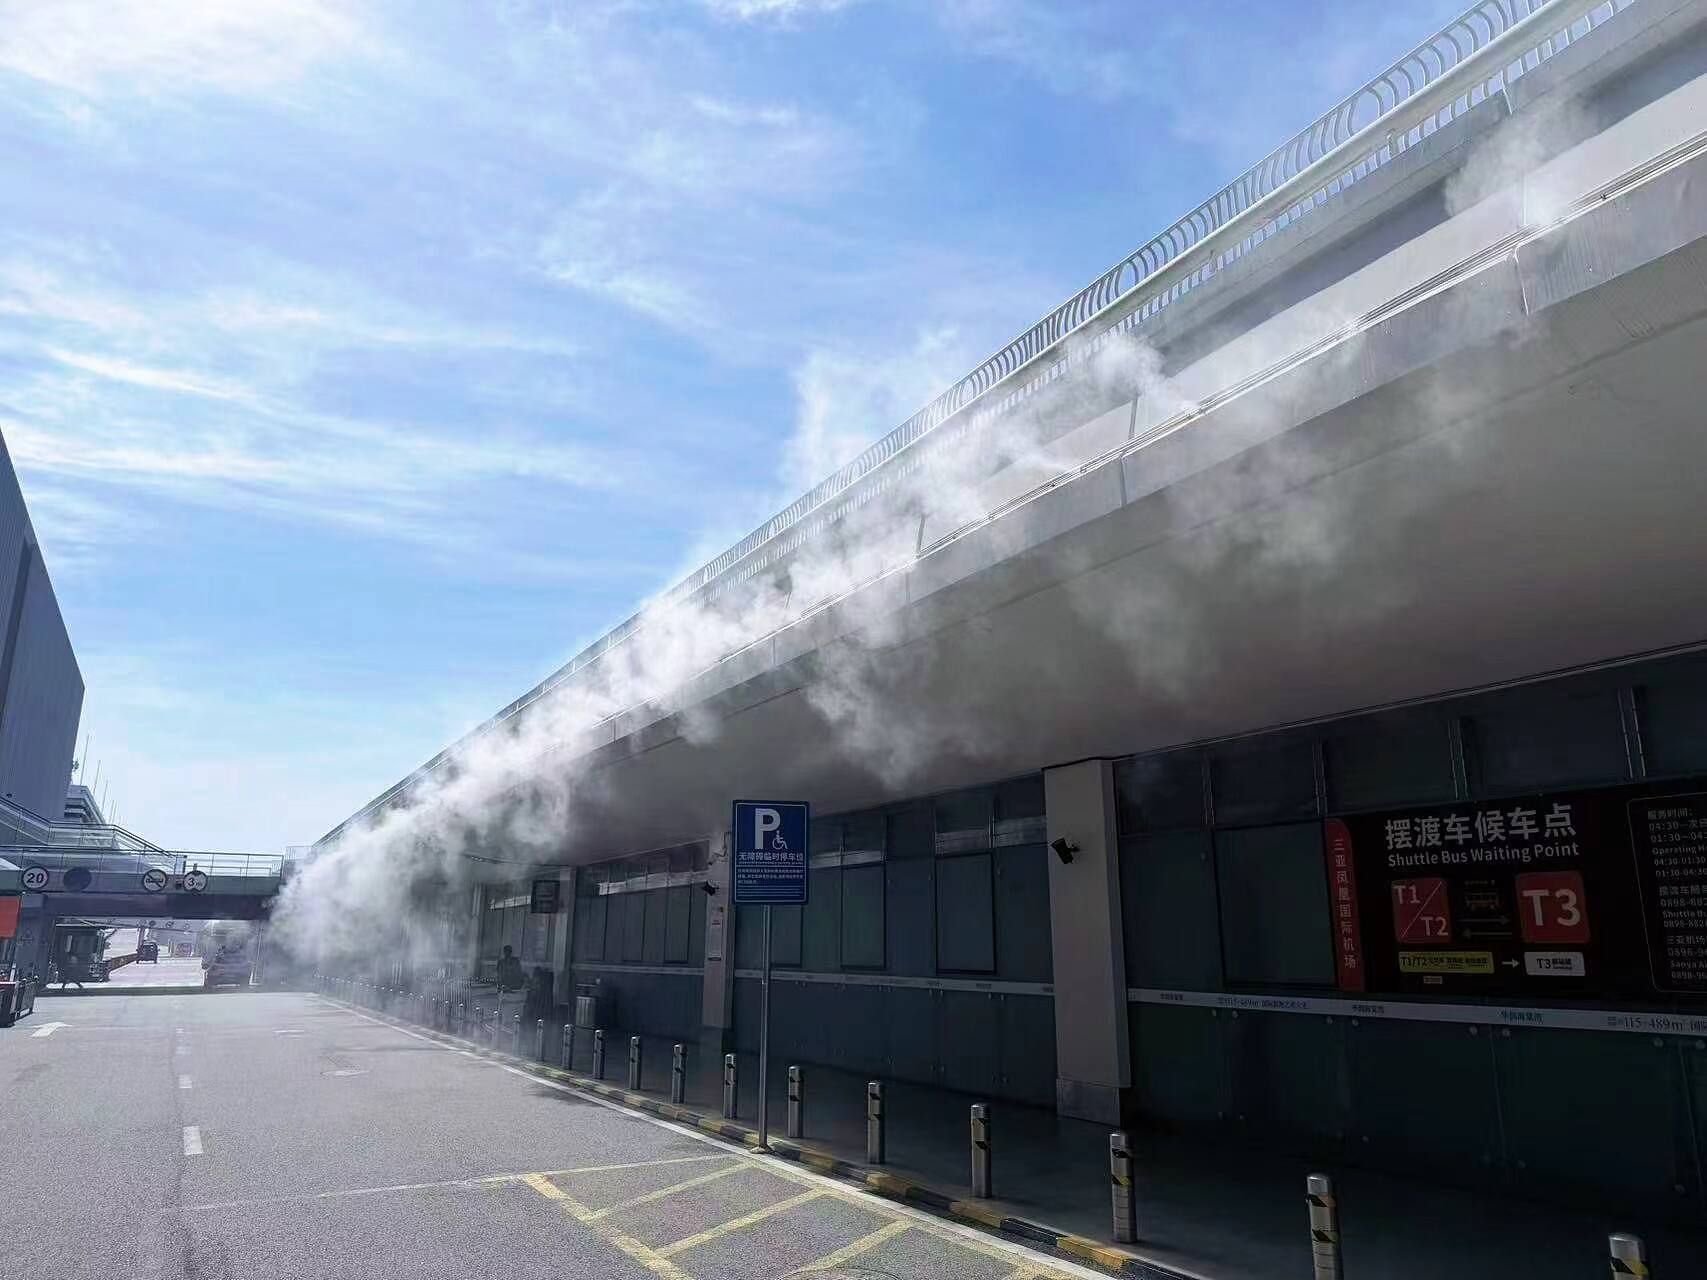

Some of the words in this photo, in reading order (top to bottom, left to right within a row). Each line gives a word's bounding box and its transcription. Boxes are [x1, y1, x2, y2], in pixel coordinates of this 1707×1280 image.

[755, 808, 780, 849] P
[1385, 803, 1576, 850] 摆渡车候车点
[1388, 852, 1439, 867] Shuttle
[1441, 850, 1468, 864] Bus
[1470, 846, 1531, 863] Waiting
[1533, 842, 1580, 858] Point
[25, 872, 44, 884] 20
[1393, 885, 1420, 904] T1
[1522, 888, 1581, 926] T3
[1420, 917, 1449, 936] T2
